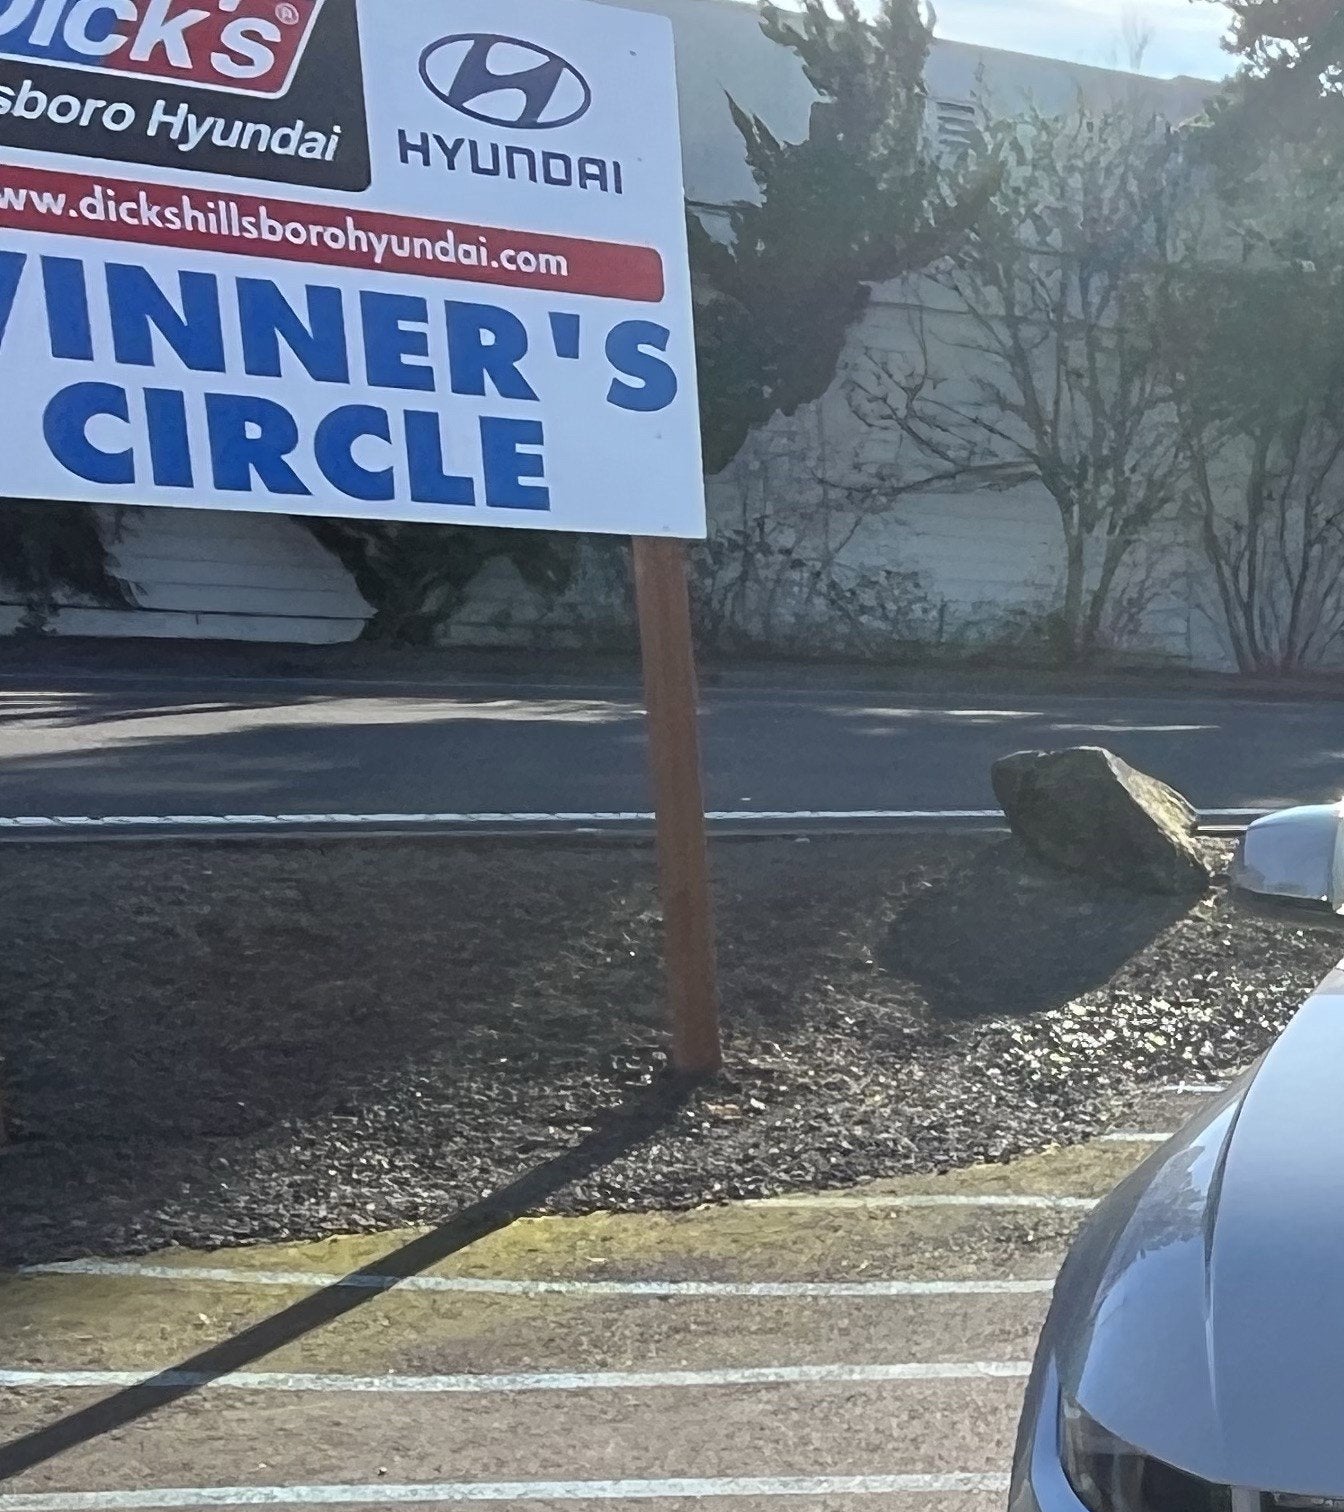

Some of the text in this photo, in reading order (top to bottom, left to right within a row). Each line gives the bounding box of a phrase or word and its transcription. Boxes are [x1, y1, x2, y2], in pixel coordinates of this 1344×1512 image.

[147, 99, 342, 162] Hyundai
[397, 128, 623, 195] HYUNDAI
[43, 381, 551, 512] CIRCLE
